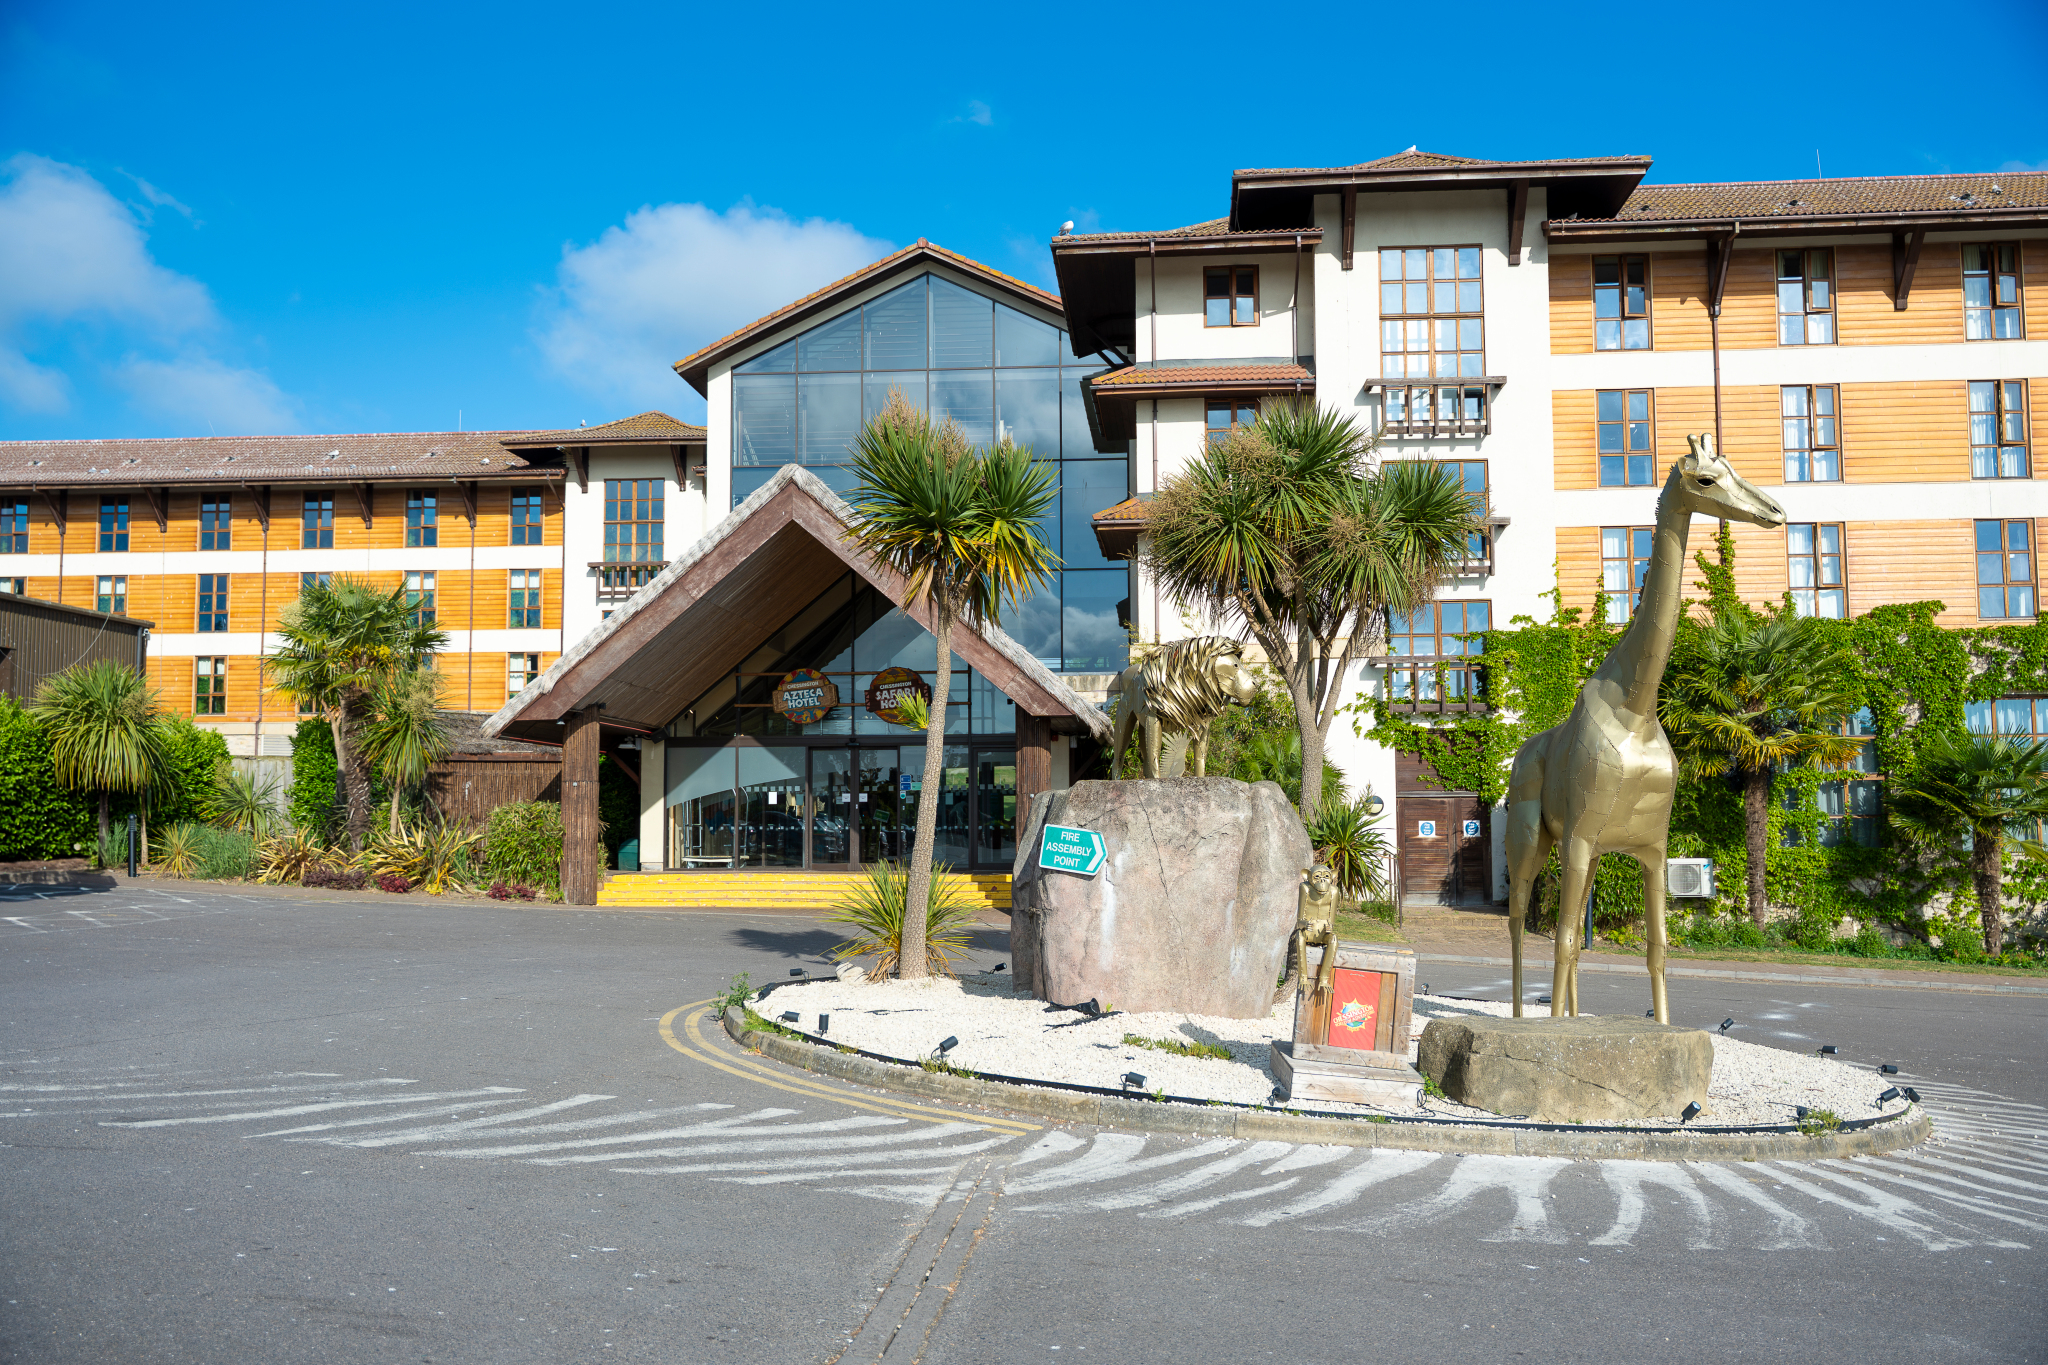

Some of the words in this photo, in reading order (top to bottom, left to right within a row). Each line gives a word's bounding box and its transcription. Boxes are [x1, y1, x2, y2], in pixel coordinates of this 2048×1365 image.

[783, 688, 824, 701] AZTECA
[875, 687, 916, 700] SAFARI
[788, 697, 821, 709] HOTEL
[1061, 831, 1080, 842] FIRE
[1046, 842, 1092, 856] ASSEMBLY
[1053, 855, 1080, 867] POINT
[1333, 1004, 1374, 1024] CHESSINGTON
